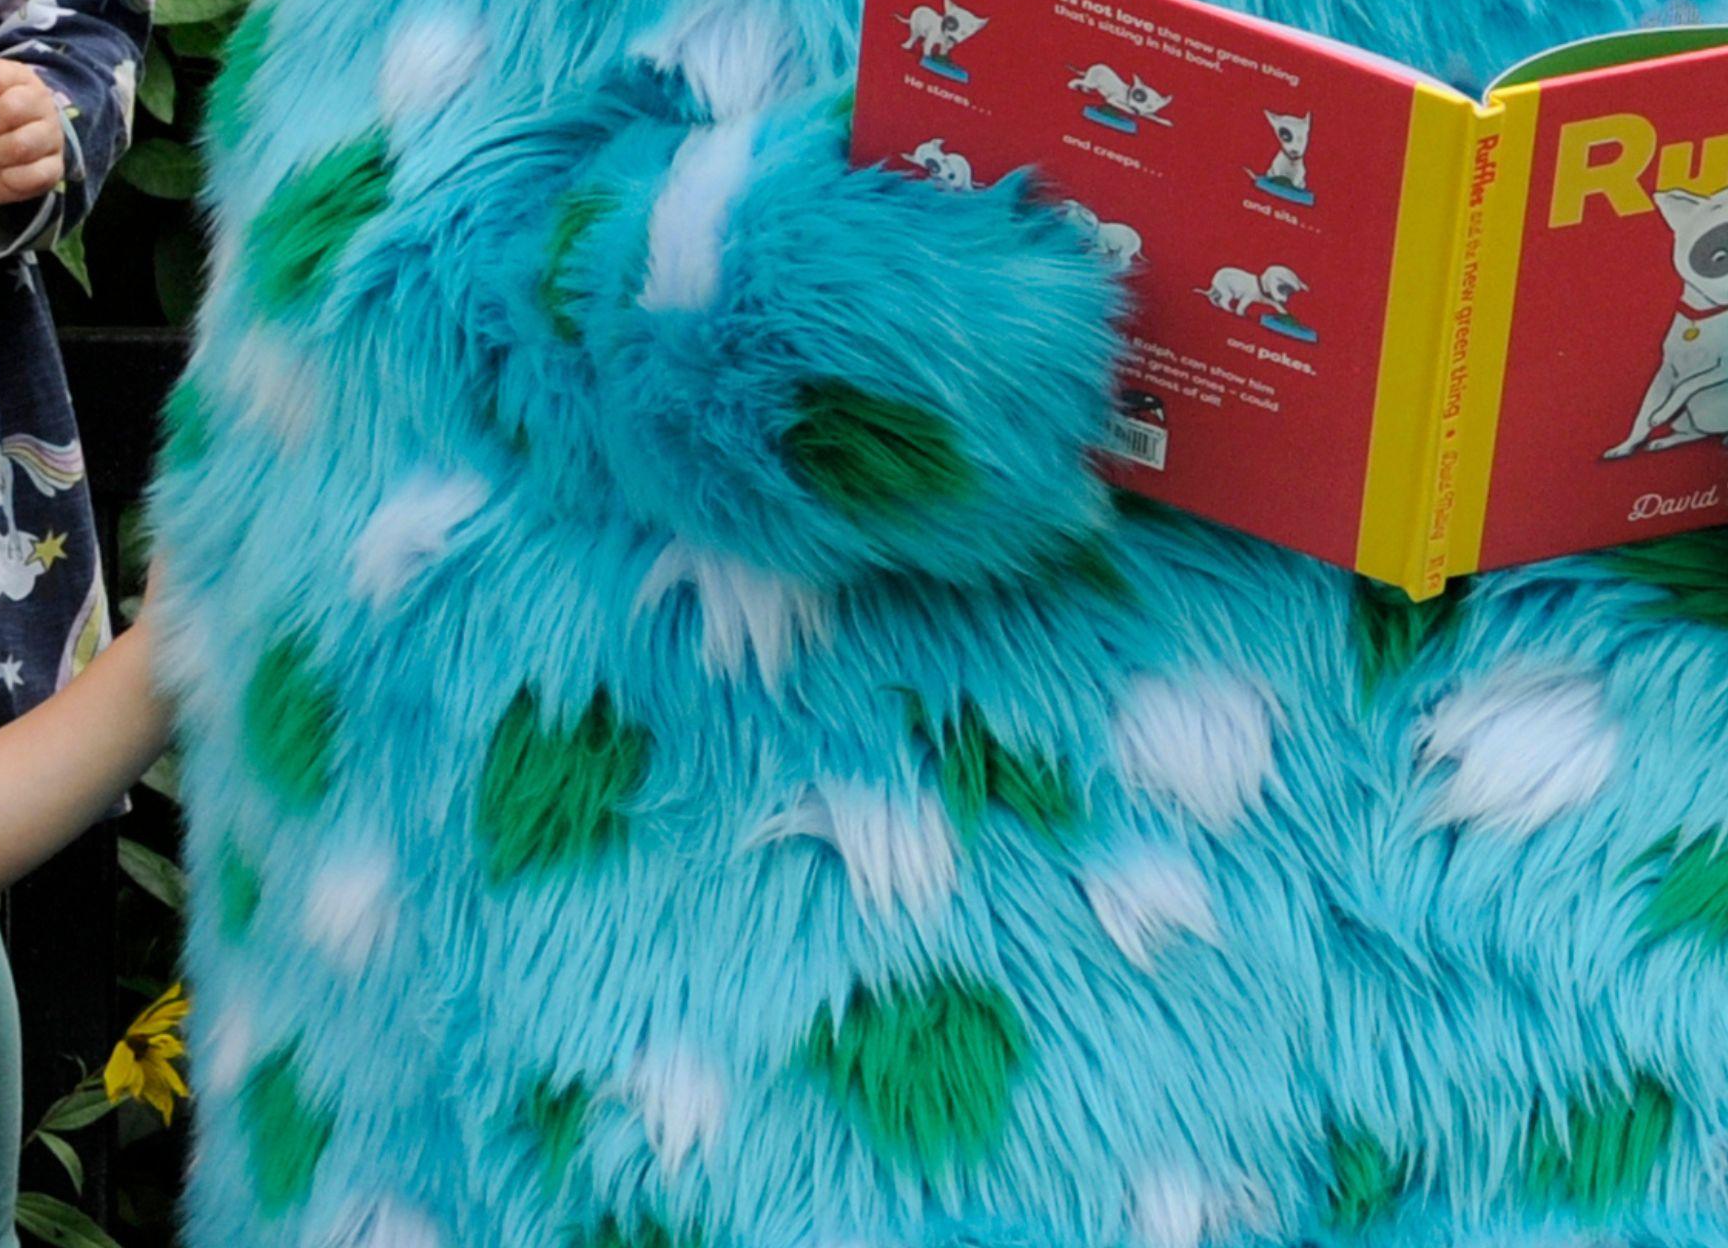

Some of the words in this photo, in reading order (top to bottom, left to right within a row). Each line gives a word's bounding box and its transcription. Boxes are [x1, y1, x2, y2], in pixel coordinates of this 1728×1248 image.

[1054, 2, 1095, 27] that's
[1098, 17, 1143, 46] sitting
[1146, 34, 1160, 51] in
[1162, 40, 1183, 59] his
[1185, 49, 1223, 73] bowl.
[1117, 8, 1155, 34] love
[1157, 24, 1182, 43] the
[1183, 36, 1215, 55] new
[1216, 44, 1259, 71] green
[1261, 62, 1300, 87] thing
[904, 73, 925, 90] He
[1062, 134, 1091, 152] and
[1469, 133, 1500, 208] Ruffles
[1242, 199, 1271, 216] and
[1460, 262, 1479, 302] new
[1452, 306, 1472, 365] green
[1180, 354, 1207, 371] can
[1210, 365, 1246, 385] show
[1248, 376, 1275, 395] him
[1227, 337, 1255, 354] and
[1257, 347, 1317, 376] pokes.
[1145, 373, 1179, 392] most
[1148, 359, 1190, 380] green
[1192, 375, 1225, 394] ones
[1239, 390, 1280, 412] could
[1443, 367, 1468, 421] thing
[1627, 484, 1720, 522] David
